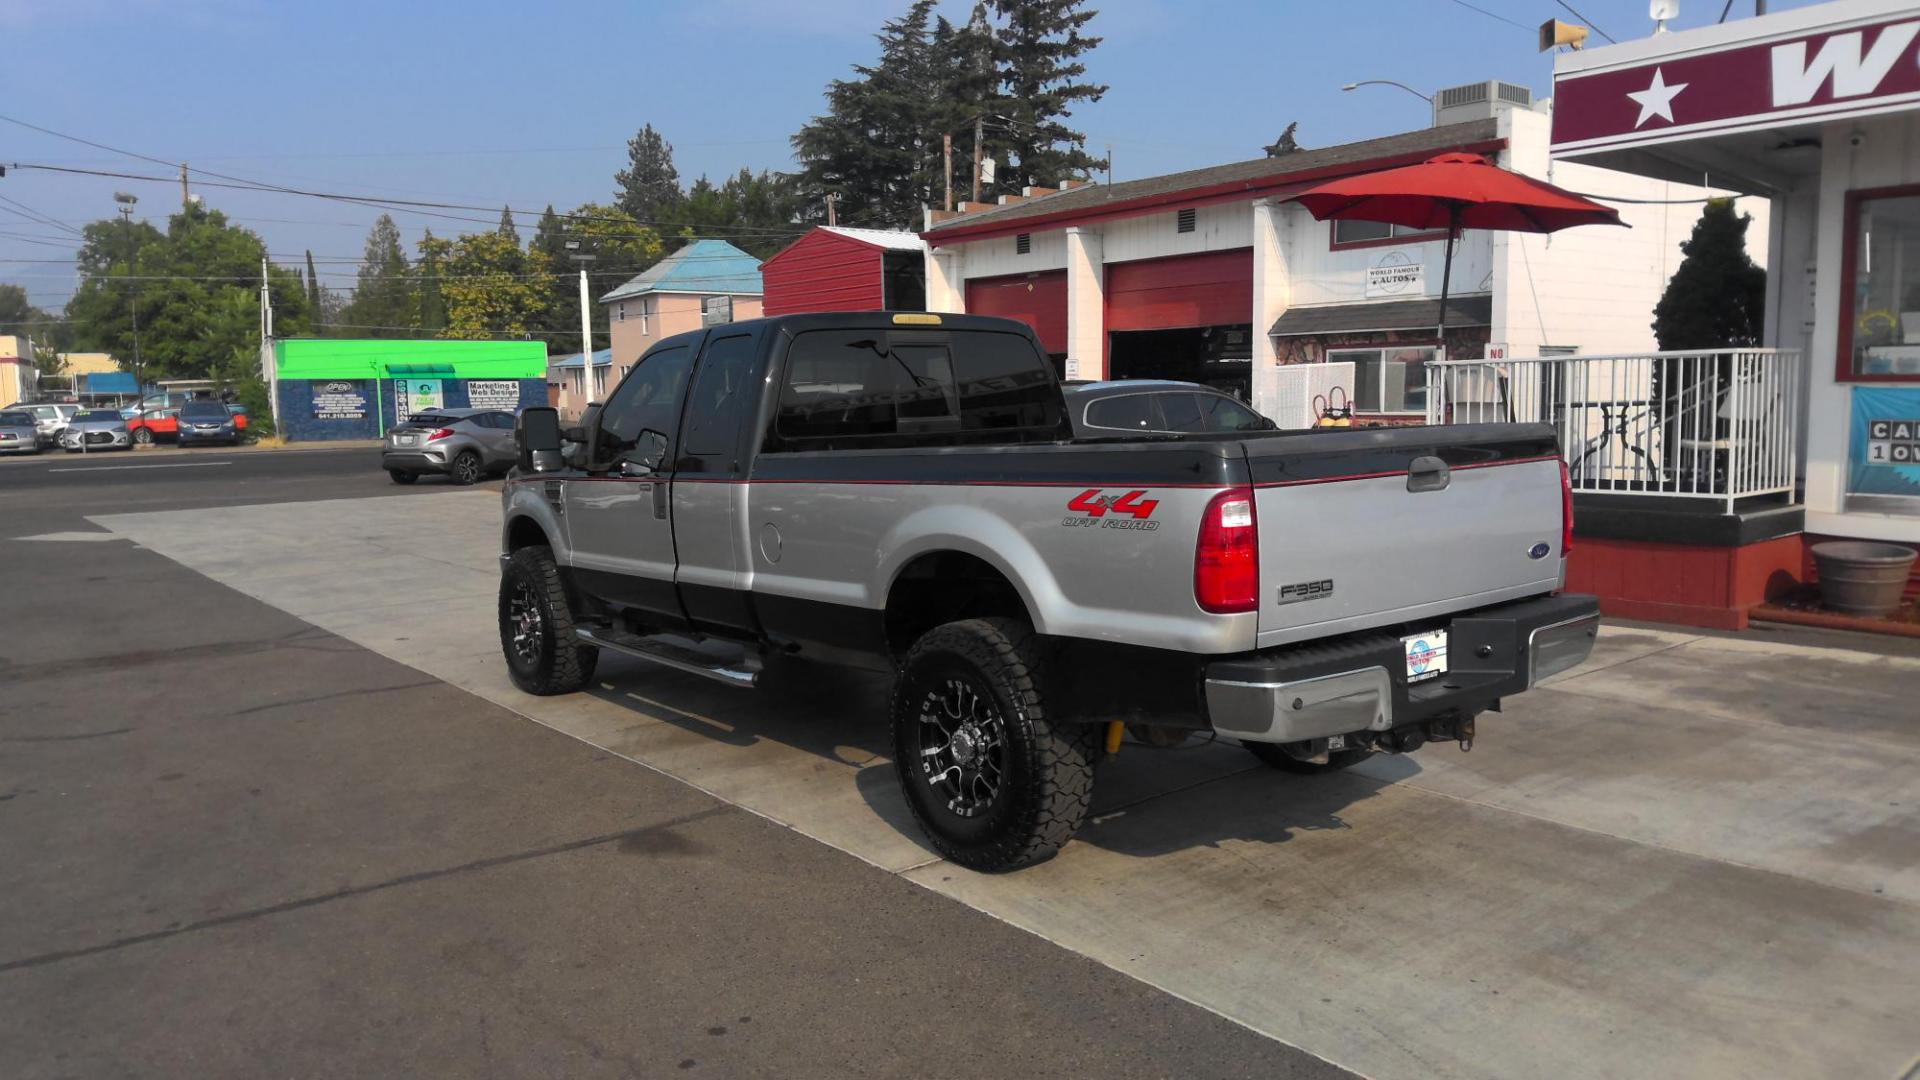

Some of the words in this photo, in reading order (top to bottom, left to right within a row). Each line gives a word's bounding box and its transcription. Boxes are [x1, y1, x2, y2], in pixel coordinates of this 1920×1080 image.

[1772, 21, 1920, 107] W
[1381, 275, 1409, 283] AUTOS
[1490, 348, 1504, 359] NO
[328, 383, 349, 391] OPEN
[470, 382, 510, 391] Marketing
[1873, 422, 1920, 439] CA
[1062, 516, 1100, 528] OFF
[1102, 519, 1160, 531] ROAD
[1281, 579, 1334, 598] F-350
